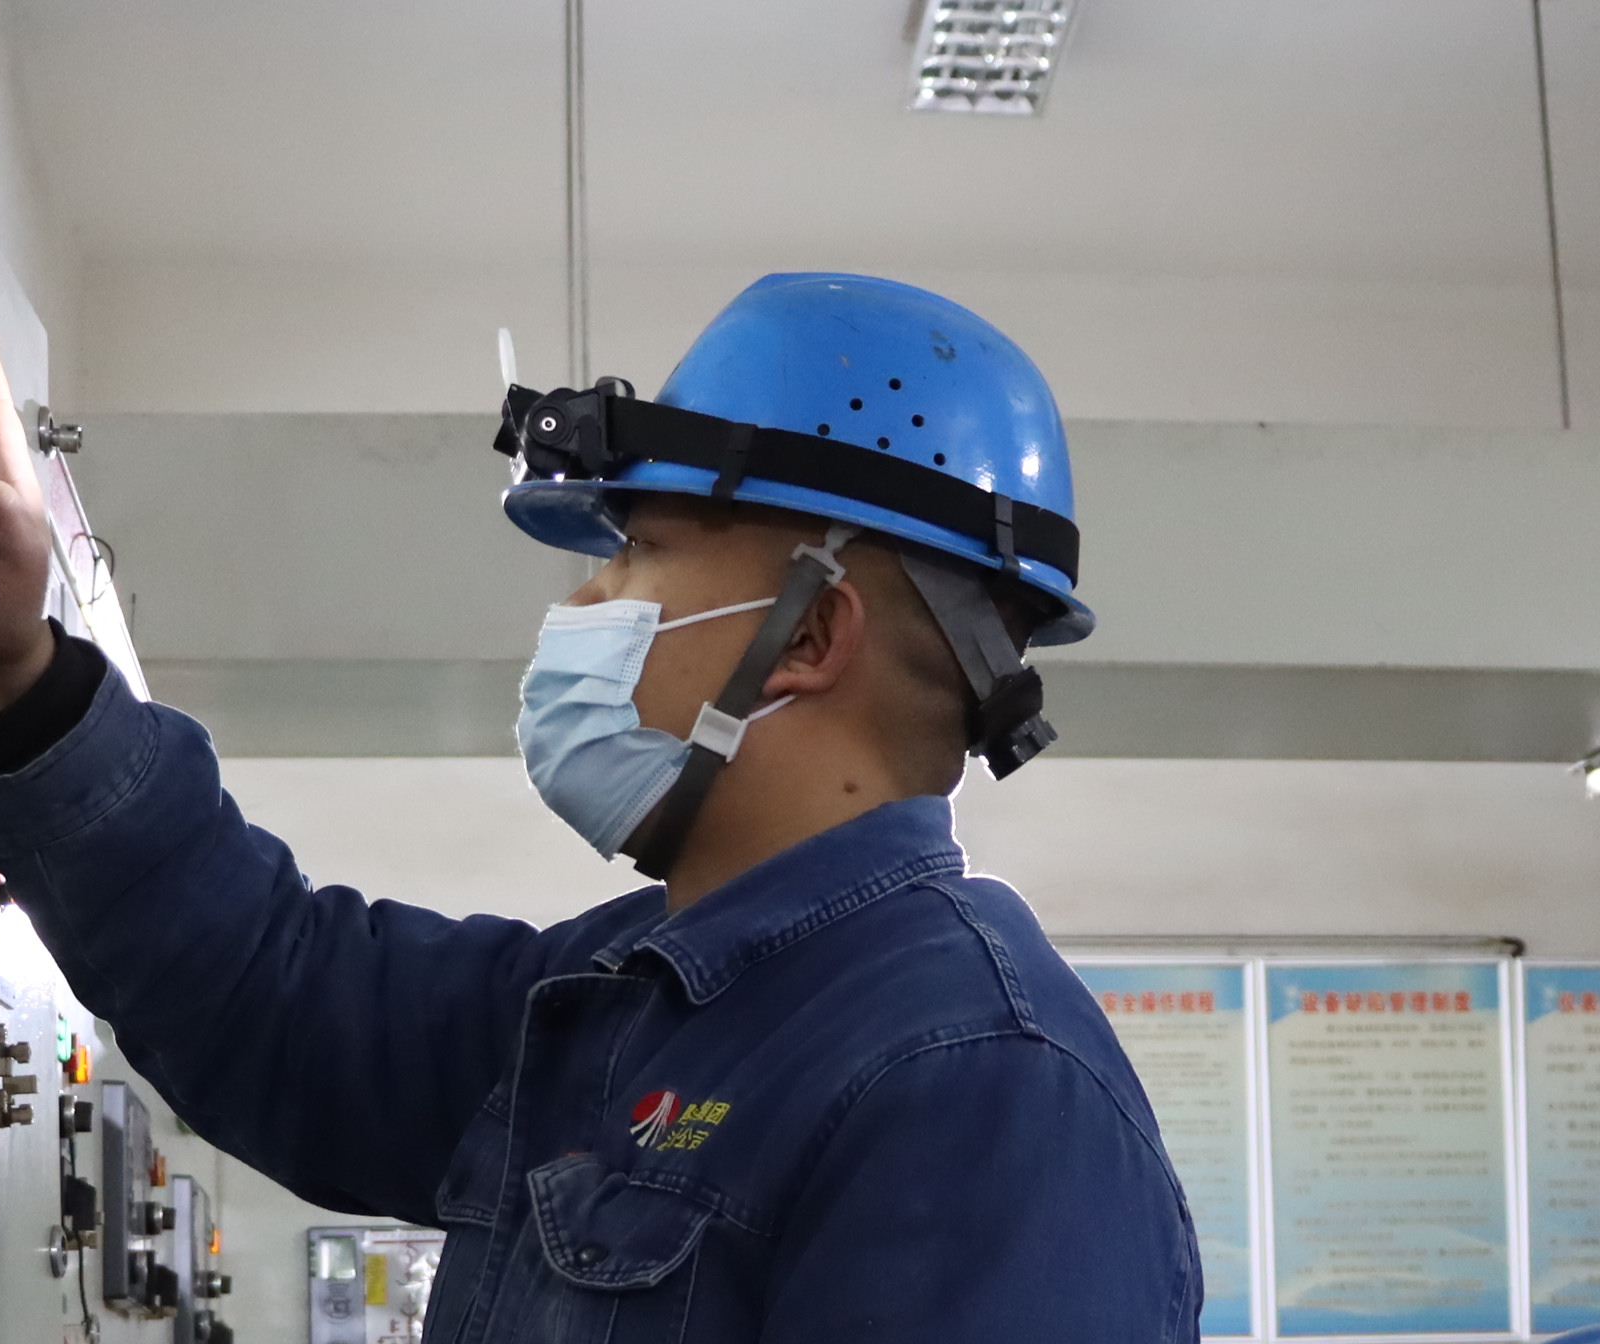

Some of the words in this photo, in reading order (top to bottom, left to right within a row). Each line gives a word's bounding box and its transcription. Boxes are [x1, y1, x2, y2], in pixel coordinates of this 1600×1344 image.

[1302, 991, 1472, 1012] 设备缺陷管理制度
